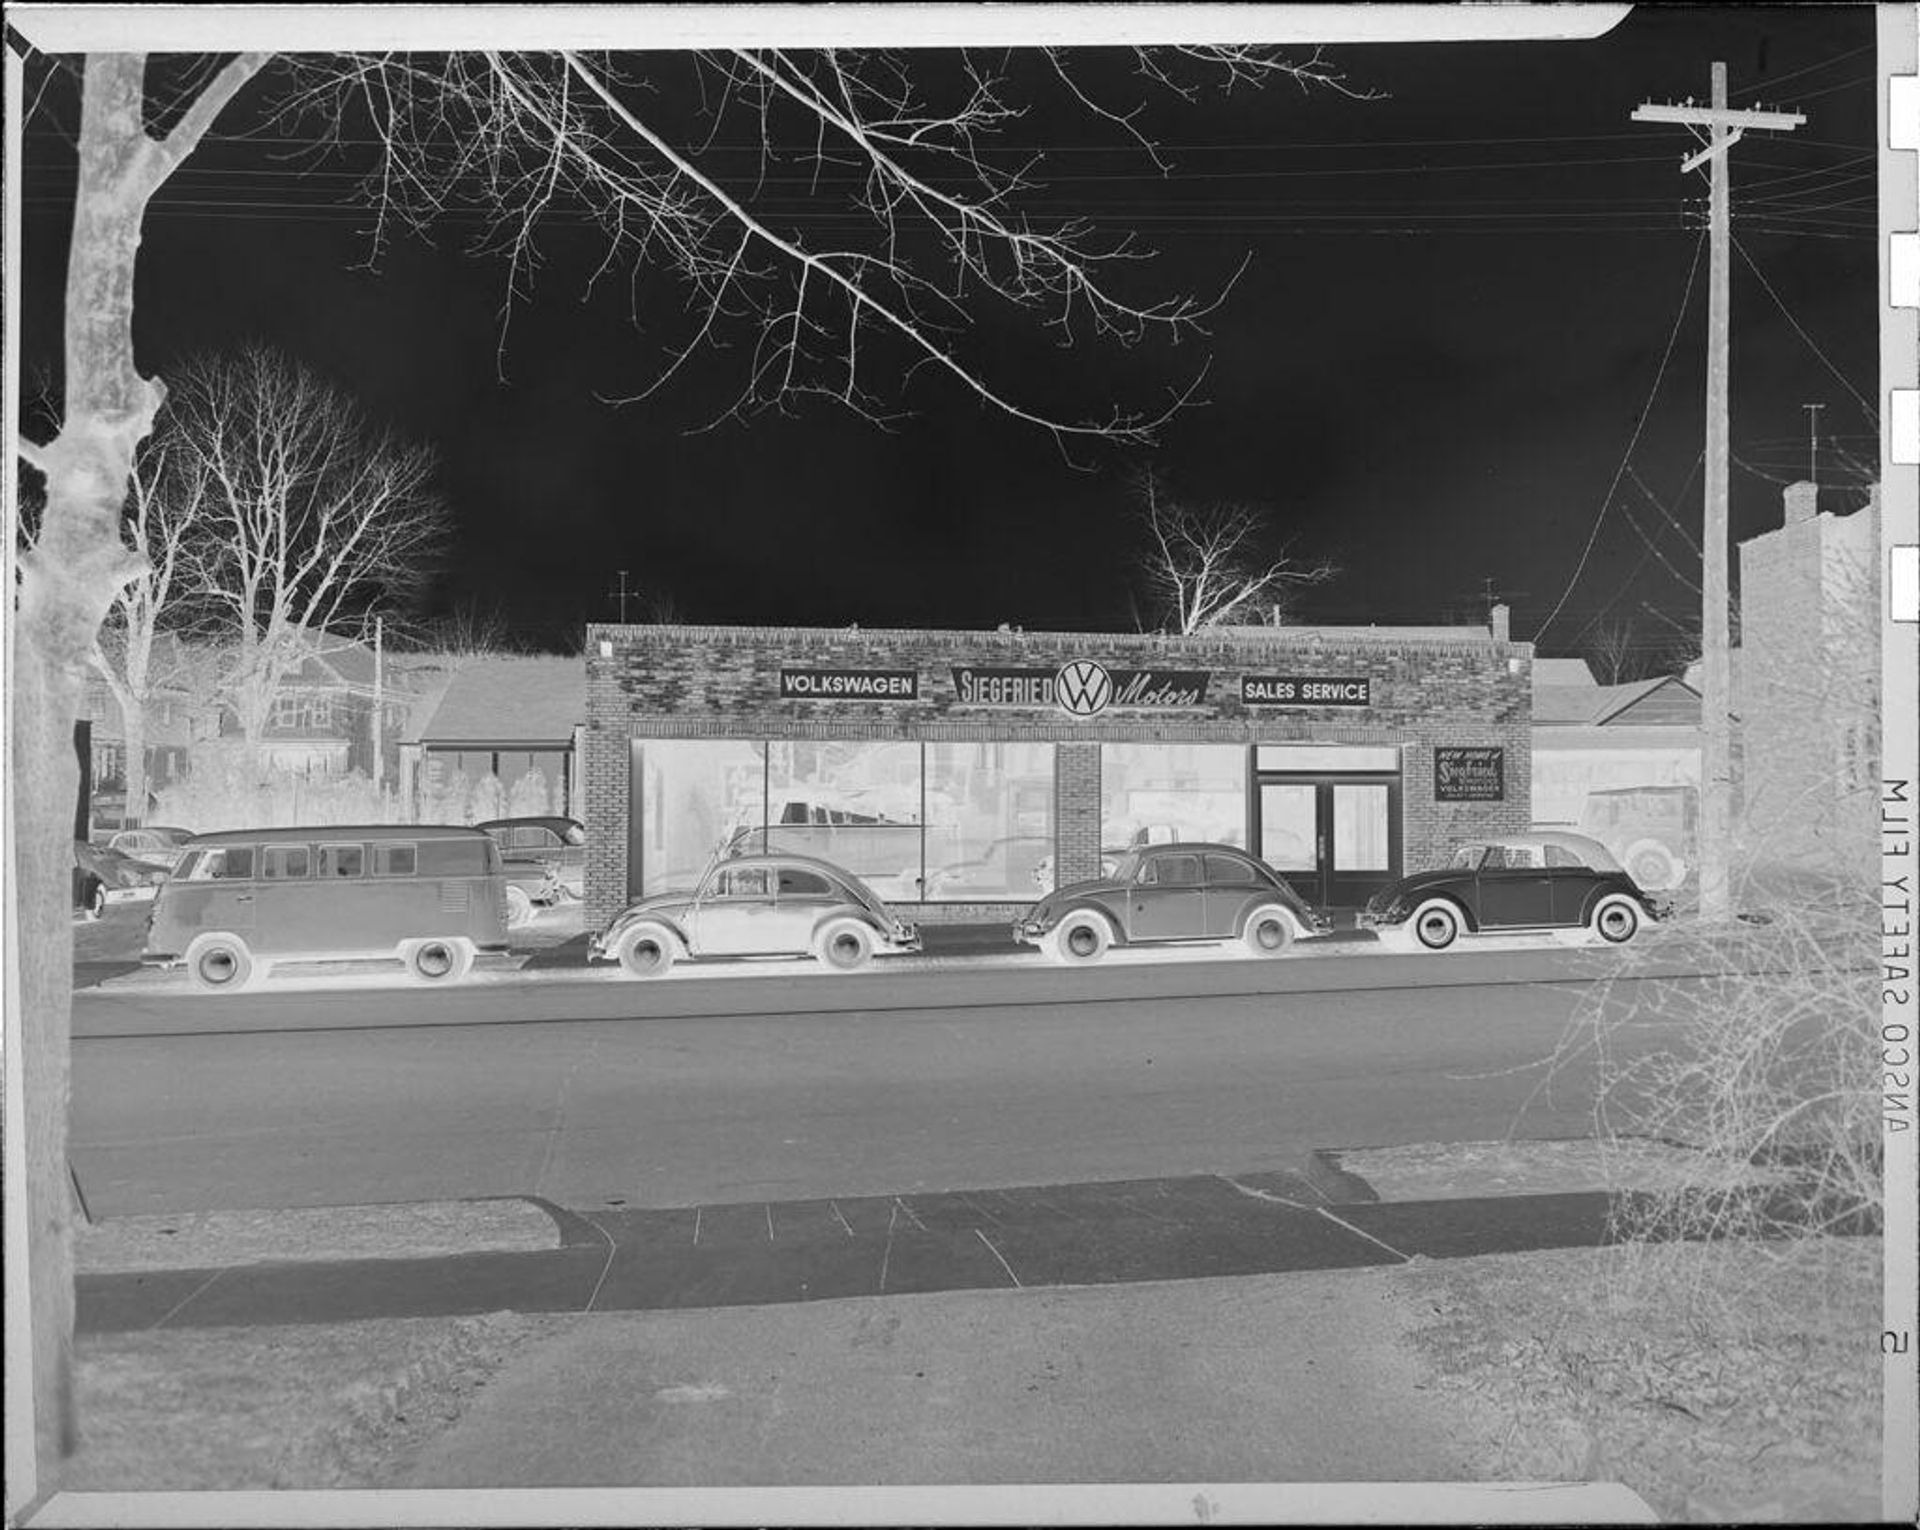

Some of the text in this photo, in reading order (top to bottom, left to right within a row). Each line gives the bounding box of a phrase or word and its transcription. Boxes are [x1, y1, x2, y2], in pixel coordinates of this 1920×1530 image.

[784, 674, 913, 695] VOLKSWAGEN
[1057, 661, 1110, 713] VW
[1116, 672, 1199, 706] Motors
[1245, 683, 1367, 701] SALES SERVICE
